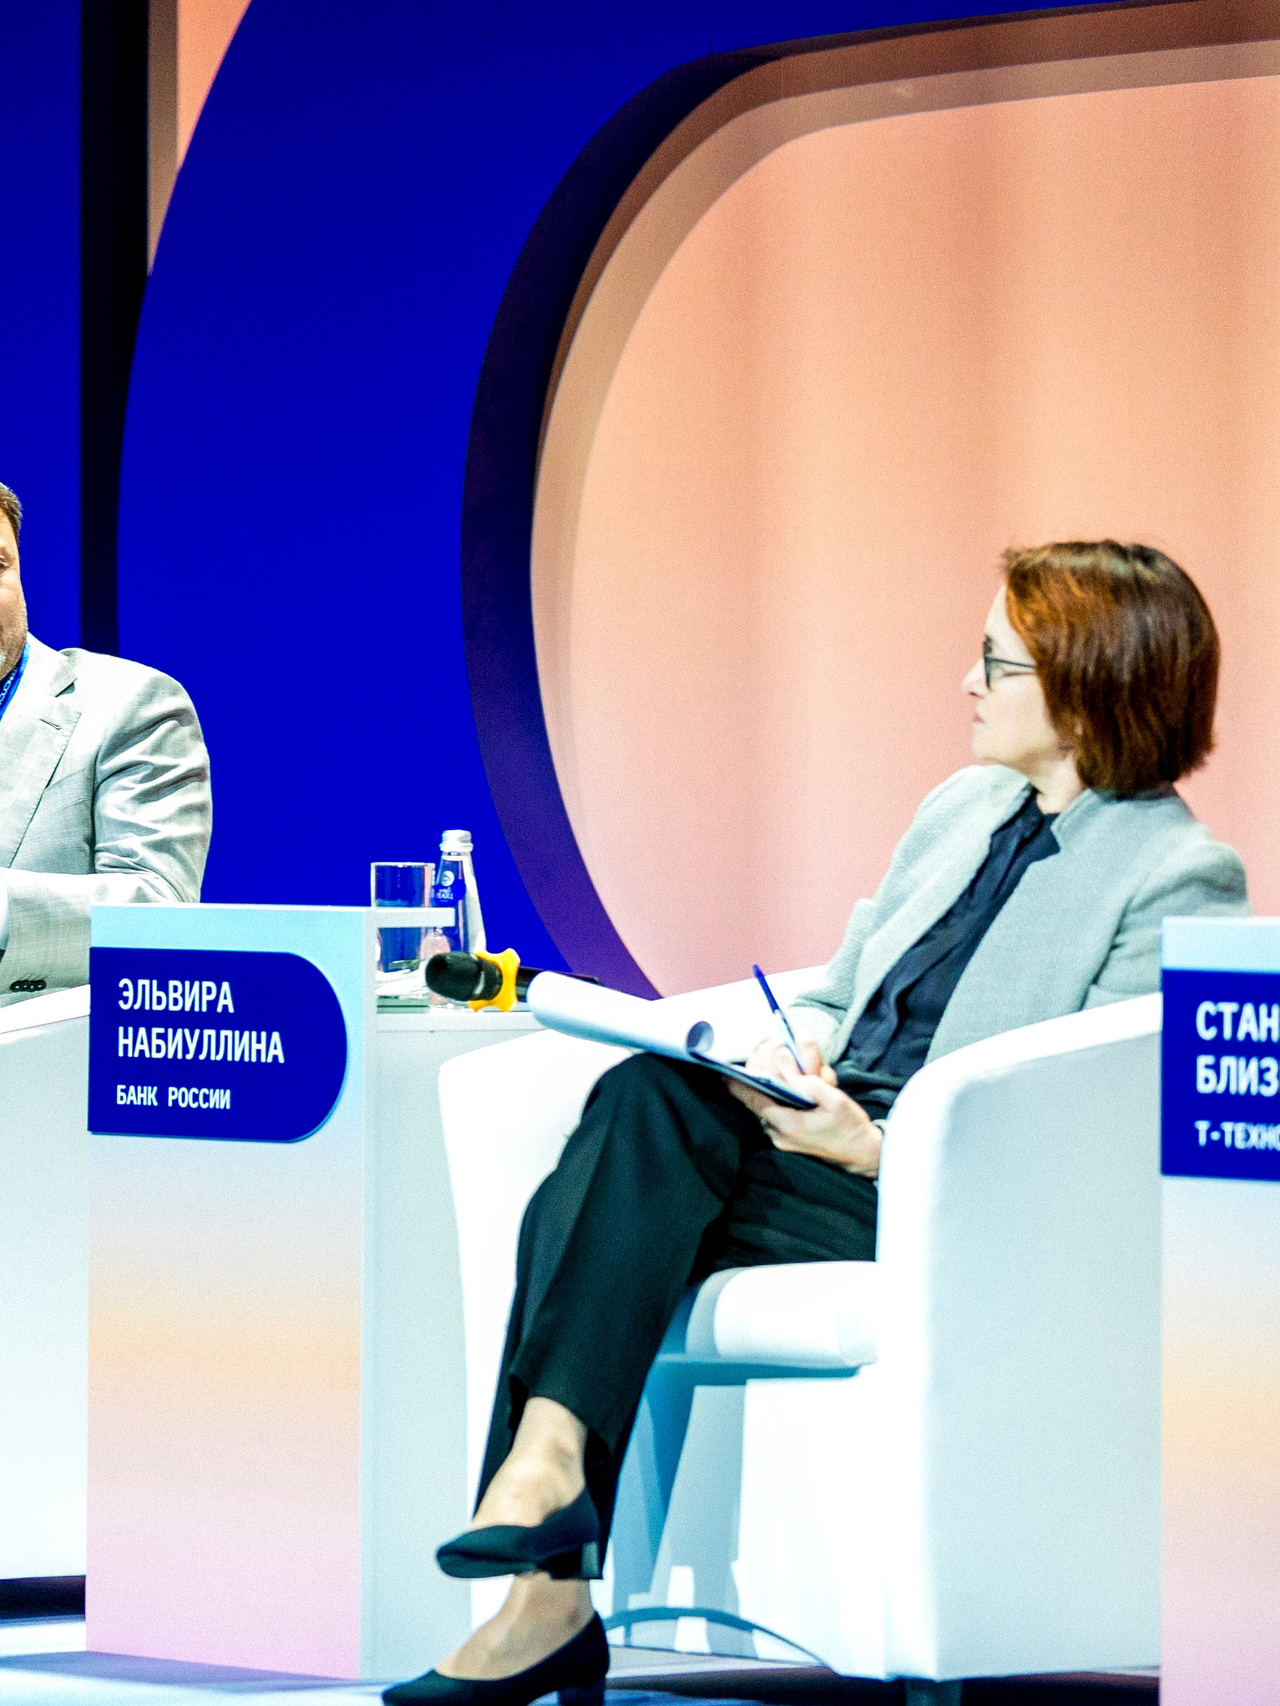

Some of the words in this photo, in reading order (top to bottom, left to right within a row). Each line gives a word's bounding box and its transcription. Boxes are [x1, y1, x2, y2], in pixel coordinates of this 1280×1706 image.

[118, 978, 234, 1013] ЭЛЬВИРА
[1195, 1001, 1280, 1043] СТАН
[118, 1026, 285, 1063] НАБИУЛЛИНА
[116, 1084, 158, 1106] БАНК
[168, 1086, 231, 1109] РОССИИ
